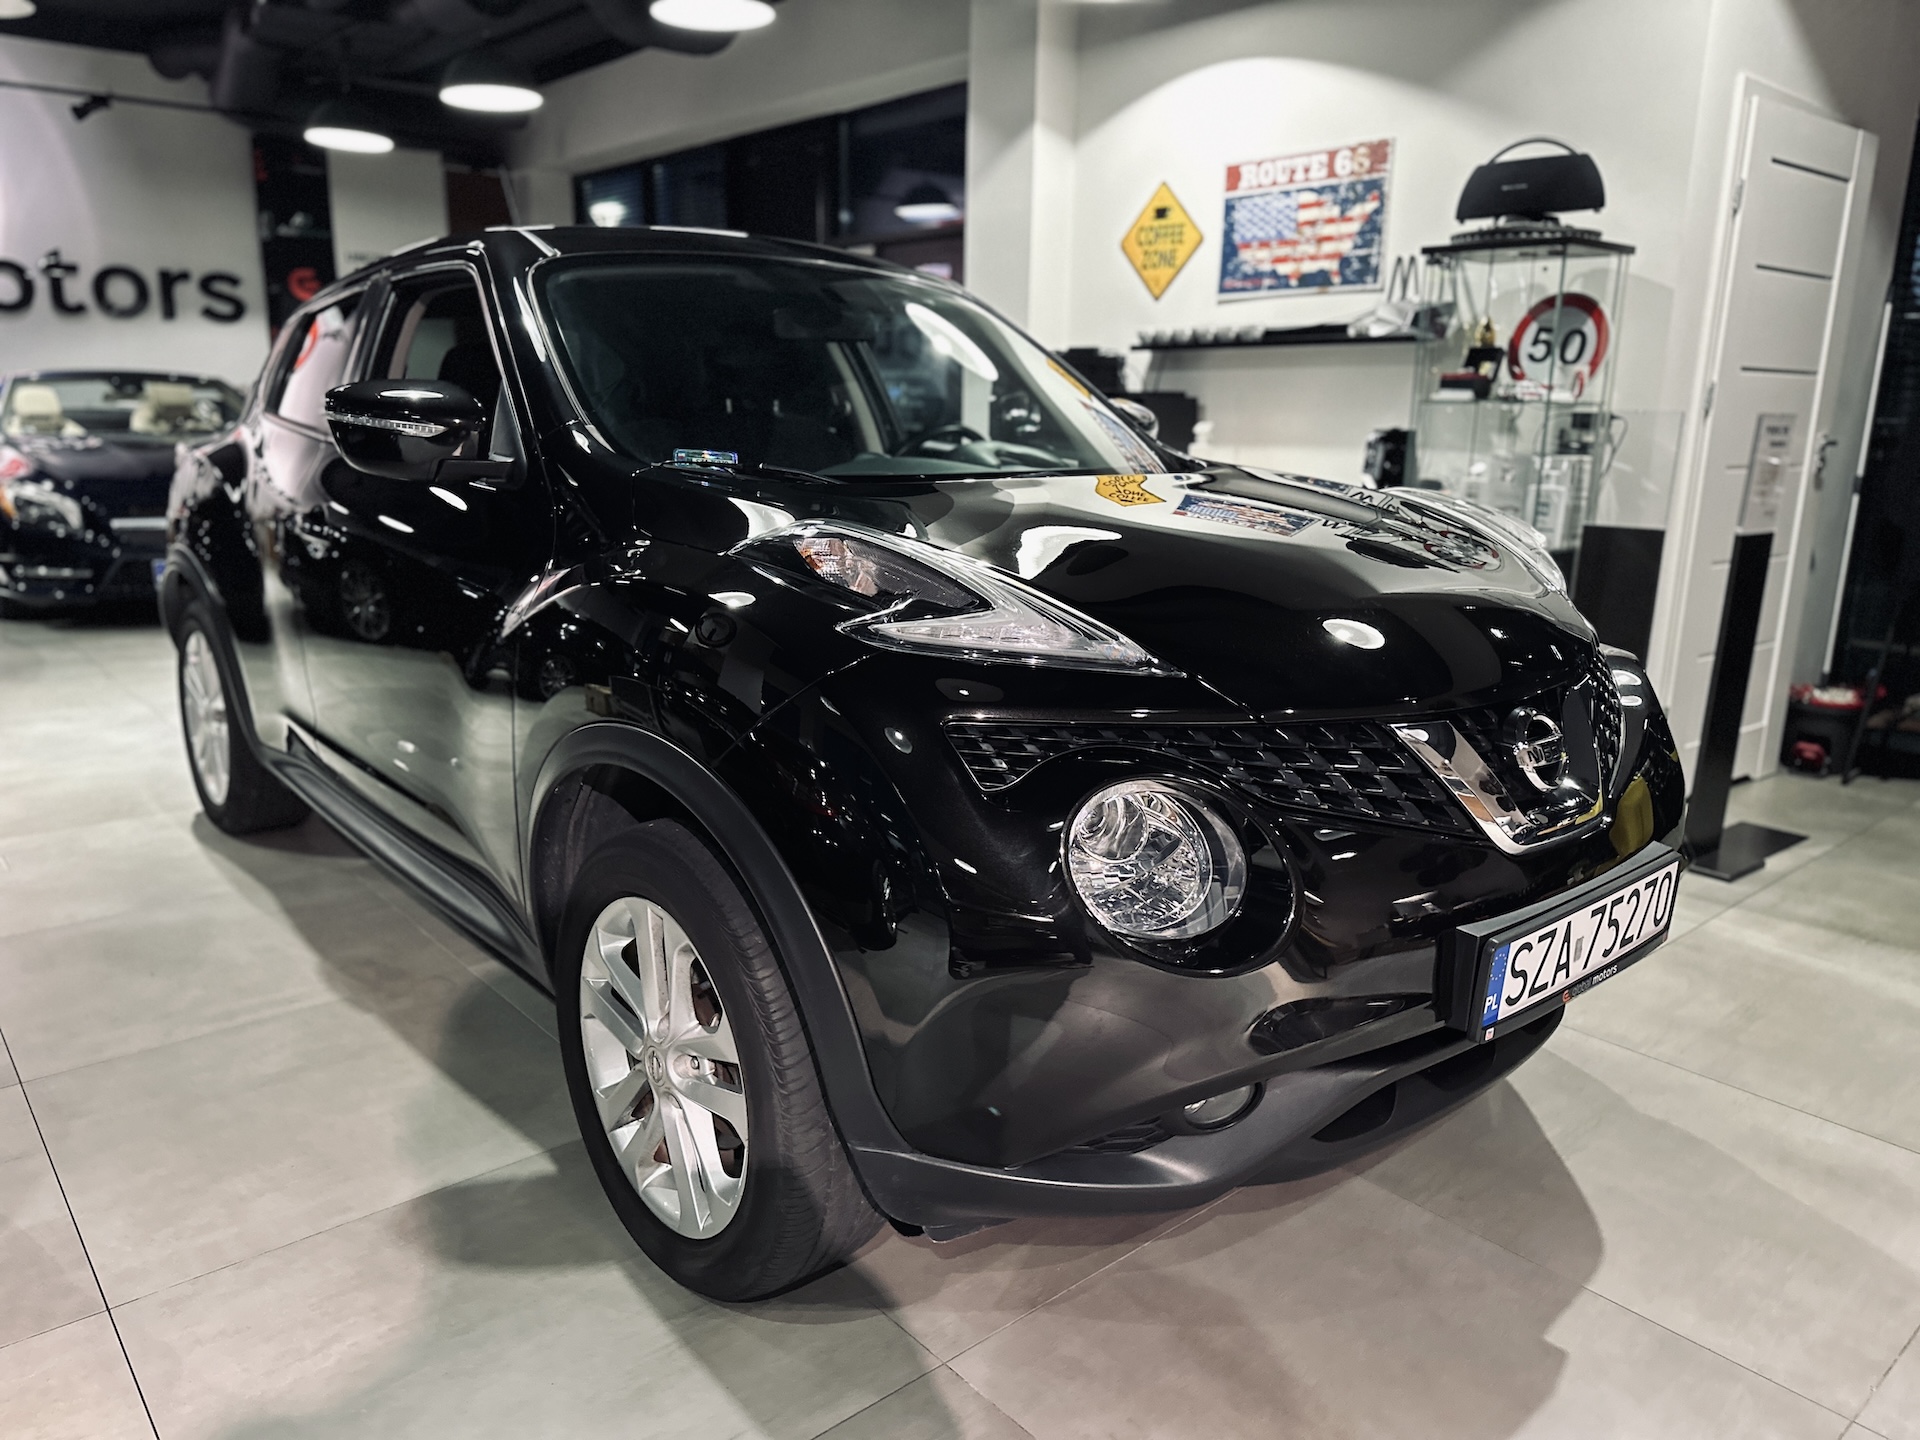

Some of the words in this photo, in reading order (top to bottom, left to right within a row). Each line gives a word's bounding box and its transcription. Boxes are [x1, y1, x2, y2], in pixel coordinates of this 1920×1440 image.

[1238, 152, 1329, 188] ROUTE
[1333, 145, 1371, 178] 66
[1135, 223, 1185, 247] COFFEE
[1142, 248, 1177, 270] ZONE
[1527, 327, 1588, 365] 50
[1505, 920, 1572, 1007] SZA
[1581, 871, 1673, 970] 75270
[1592, 964, 1618, 984] motors
[1483, 993, 1499, 1014] PL
